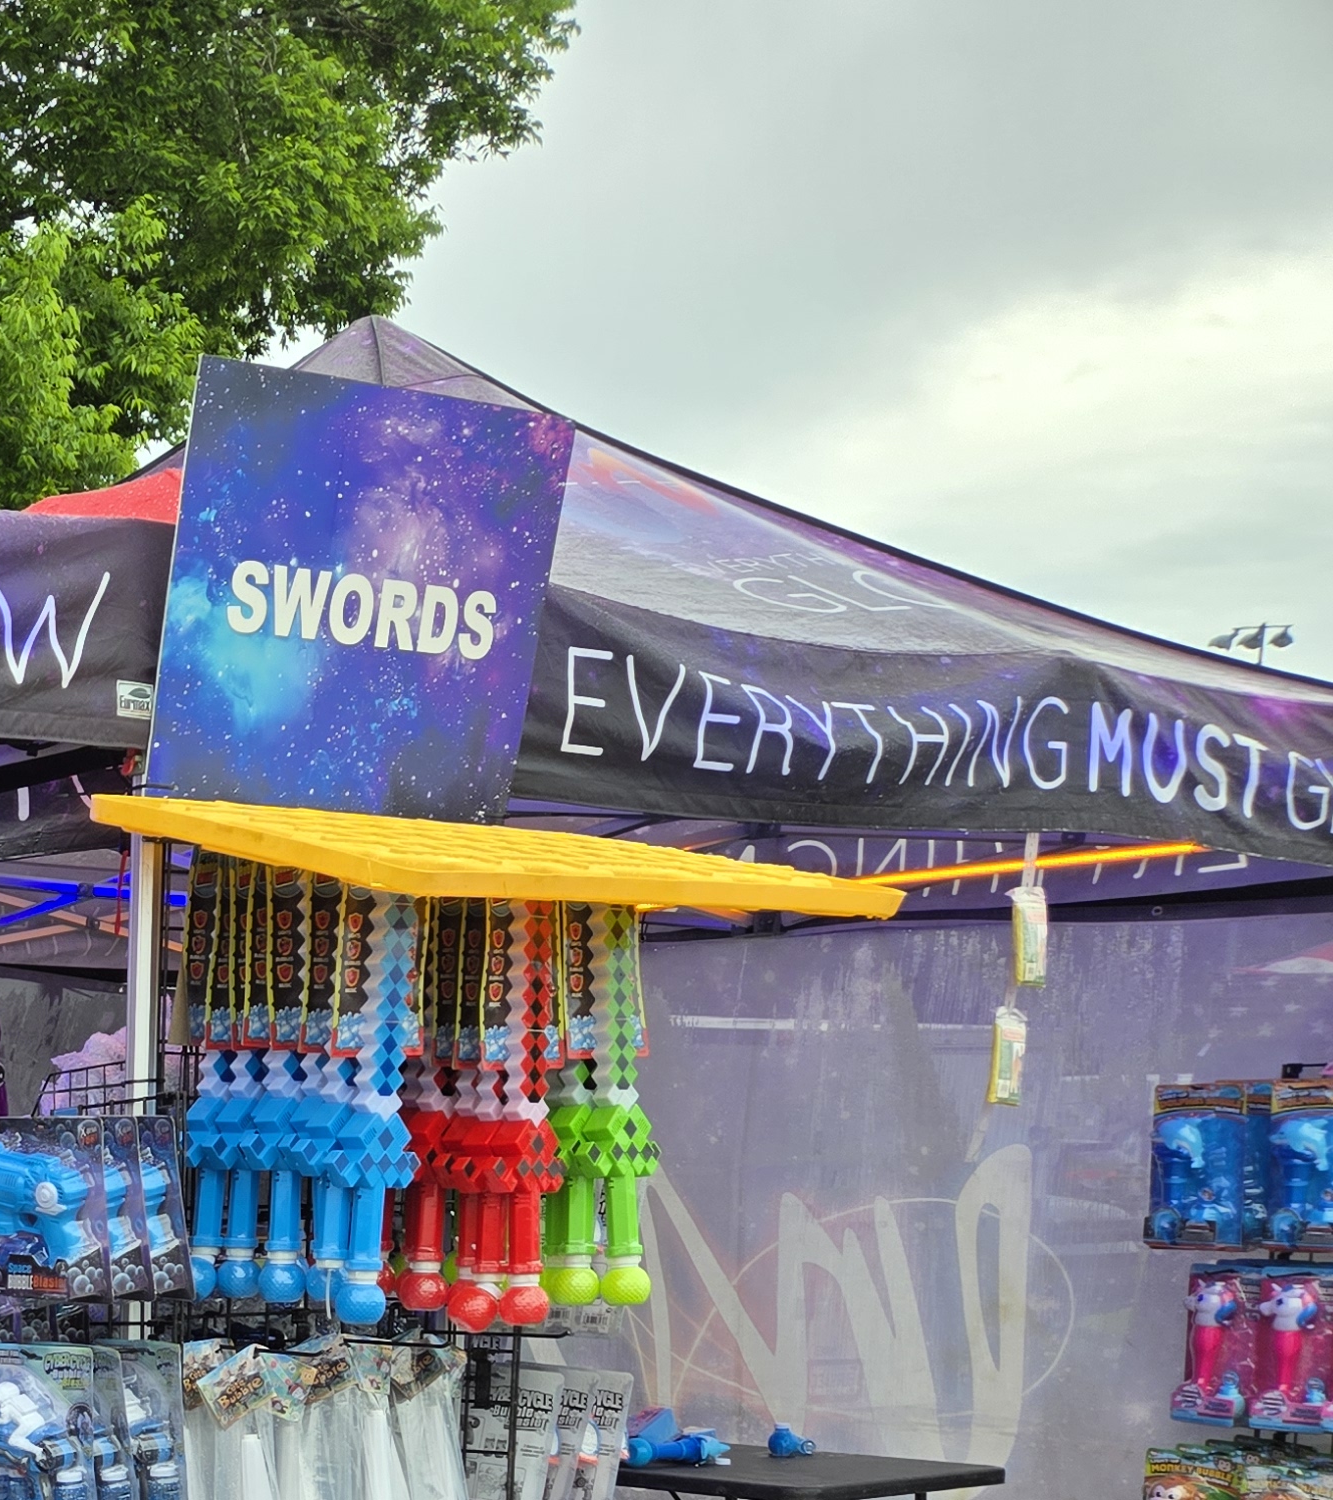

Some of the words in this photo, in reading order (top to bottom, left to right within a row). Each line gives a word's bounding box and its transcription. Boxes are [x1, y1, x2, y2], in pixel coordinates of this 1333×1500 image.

[226, 560, 497, 660] SWORDS
[561, 646, 1071, 791] EVERYTHING
[1088, 701, 1271, 818] MUST
[8, 1263, 32, 1274] Space
[8, 1274, 33, 1290] BUBBLE
[217, 1377, 264, 1408] Bubble
[225, 1380, 246, 1394] Cute
[1150, 1463, 1194, 1473] MONKEY
[1196, 1467, 1233, 1482] BUBBLE
